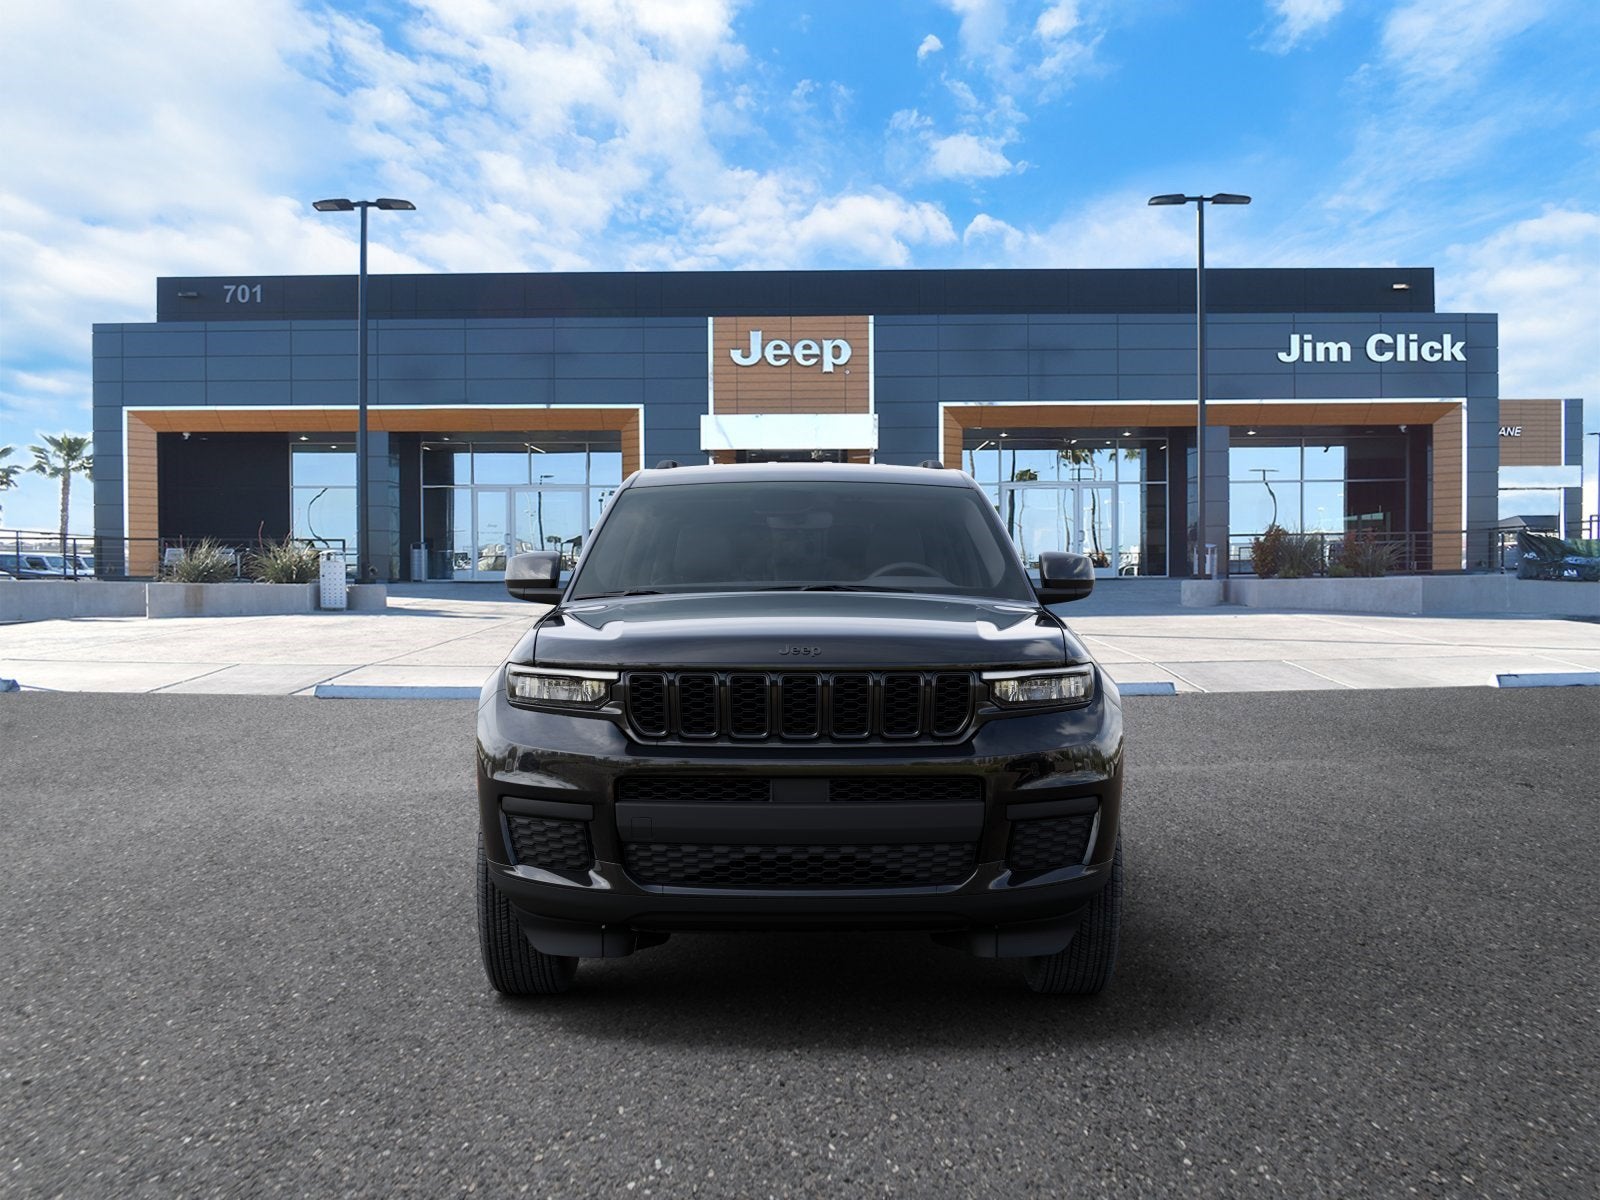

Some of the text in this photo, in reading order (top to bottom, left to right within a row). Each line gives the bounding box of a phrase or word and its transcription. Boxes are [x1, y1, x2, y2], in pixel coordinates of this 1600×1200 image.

[223, 284, 262, 304] 701
[729, 330, 852, 374] Jeep
[1277, 332, 1468, 363] Jim Click
[778, 643, 823, 659] Jeep
